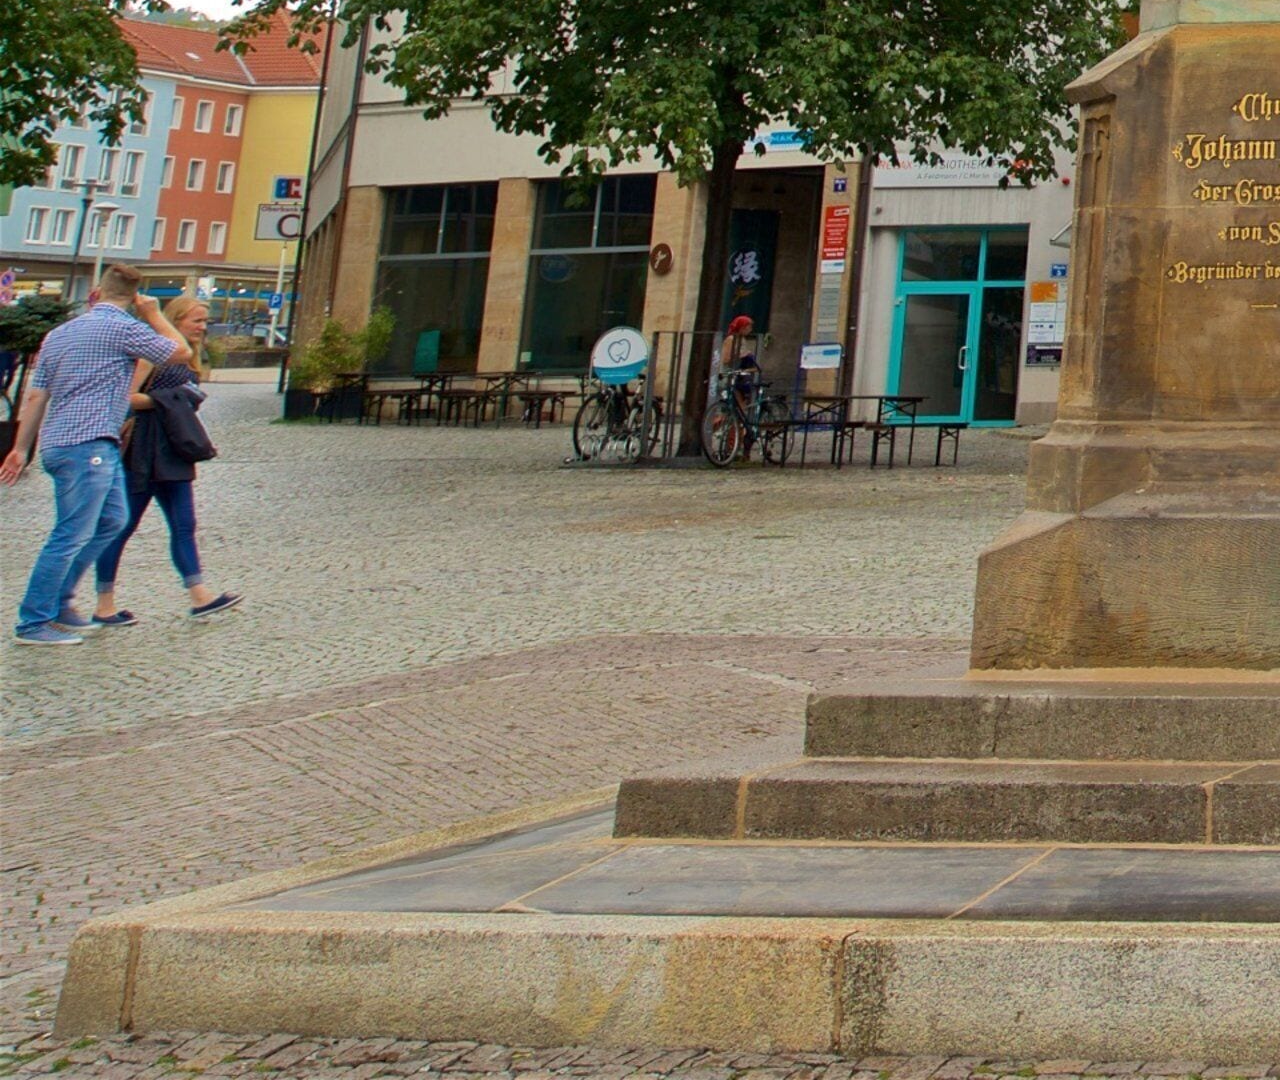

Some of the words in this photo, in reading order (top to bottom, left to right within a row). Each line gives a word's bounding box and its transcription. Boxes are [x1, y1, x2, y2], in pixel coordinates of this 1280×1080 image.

[1185, 133, 1276, 169] Johann
[1201, 180, 1232, 201] der
[1227, 225, 1262, 241] von
[1172, 260, 1261, 283] Begründer
